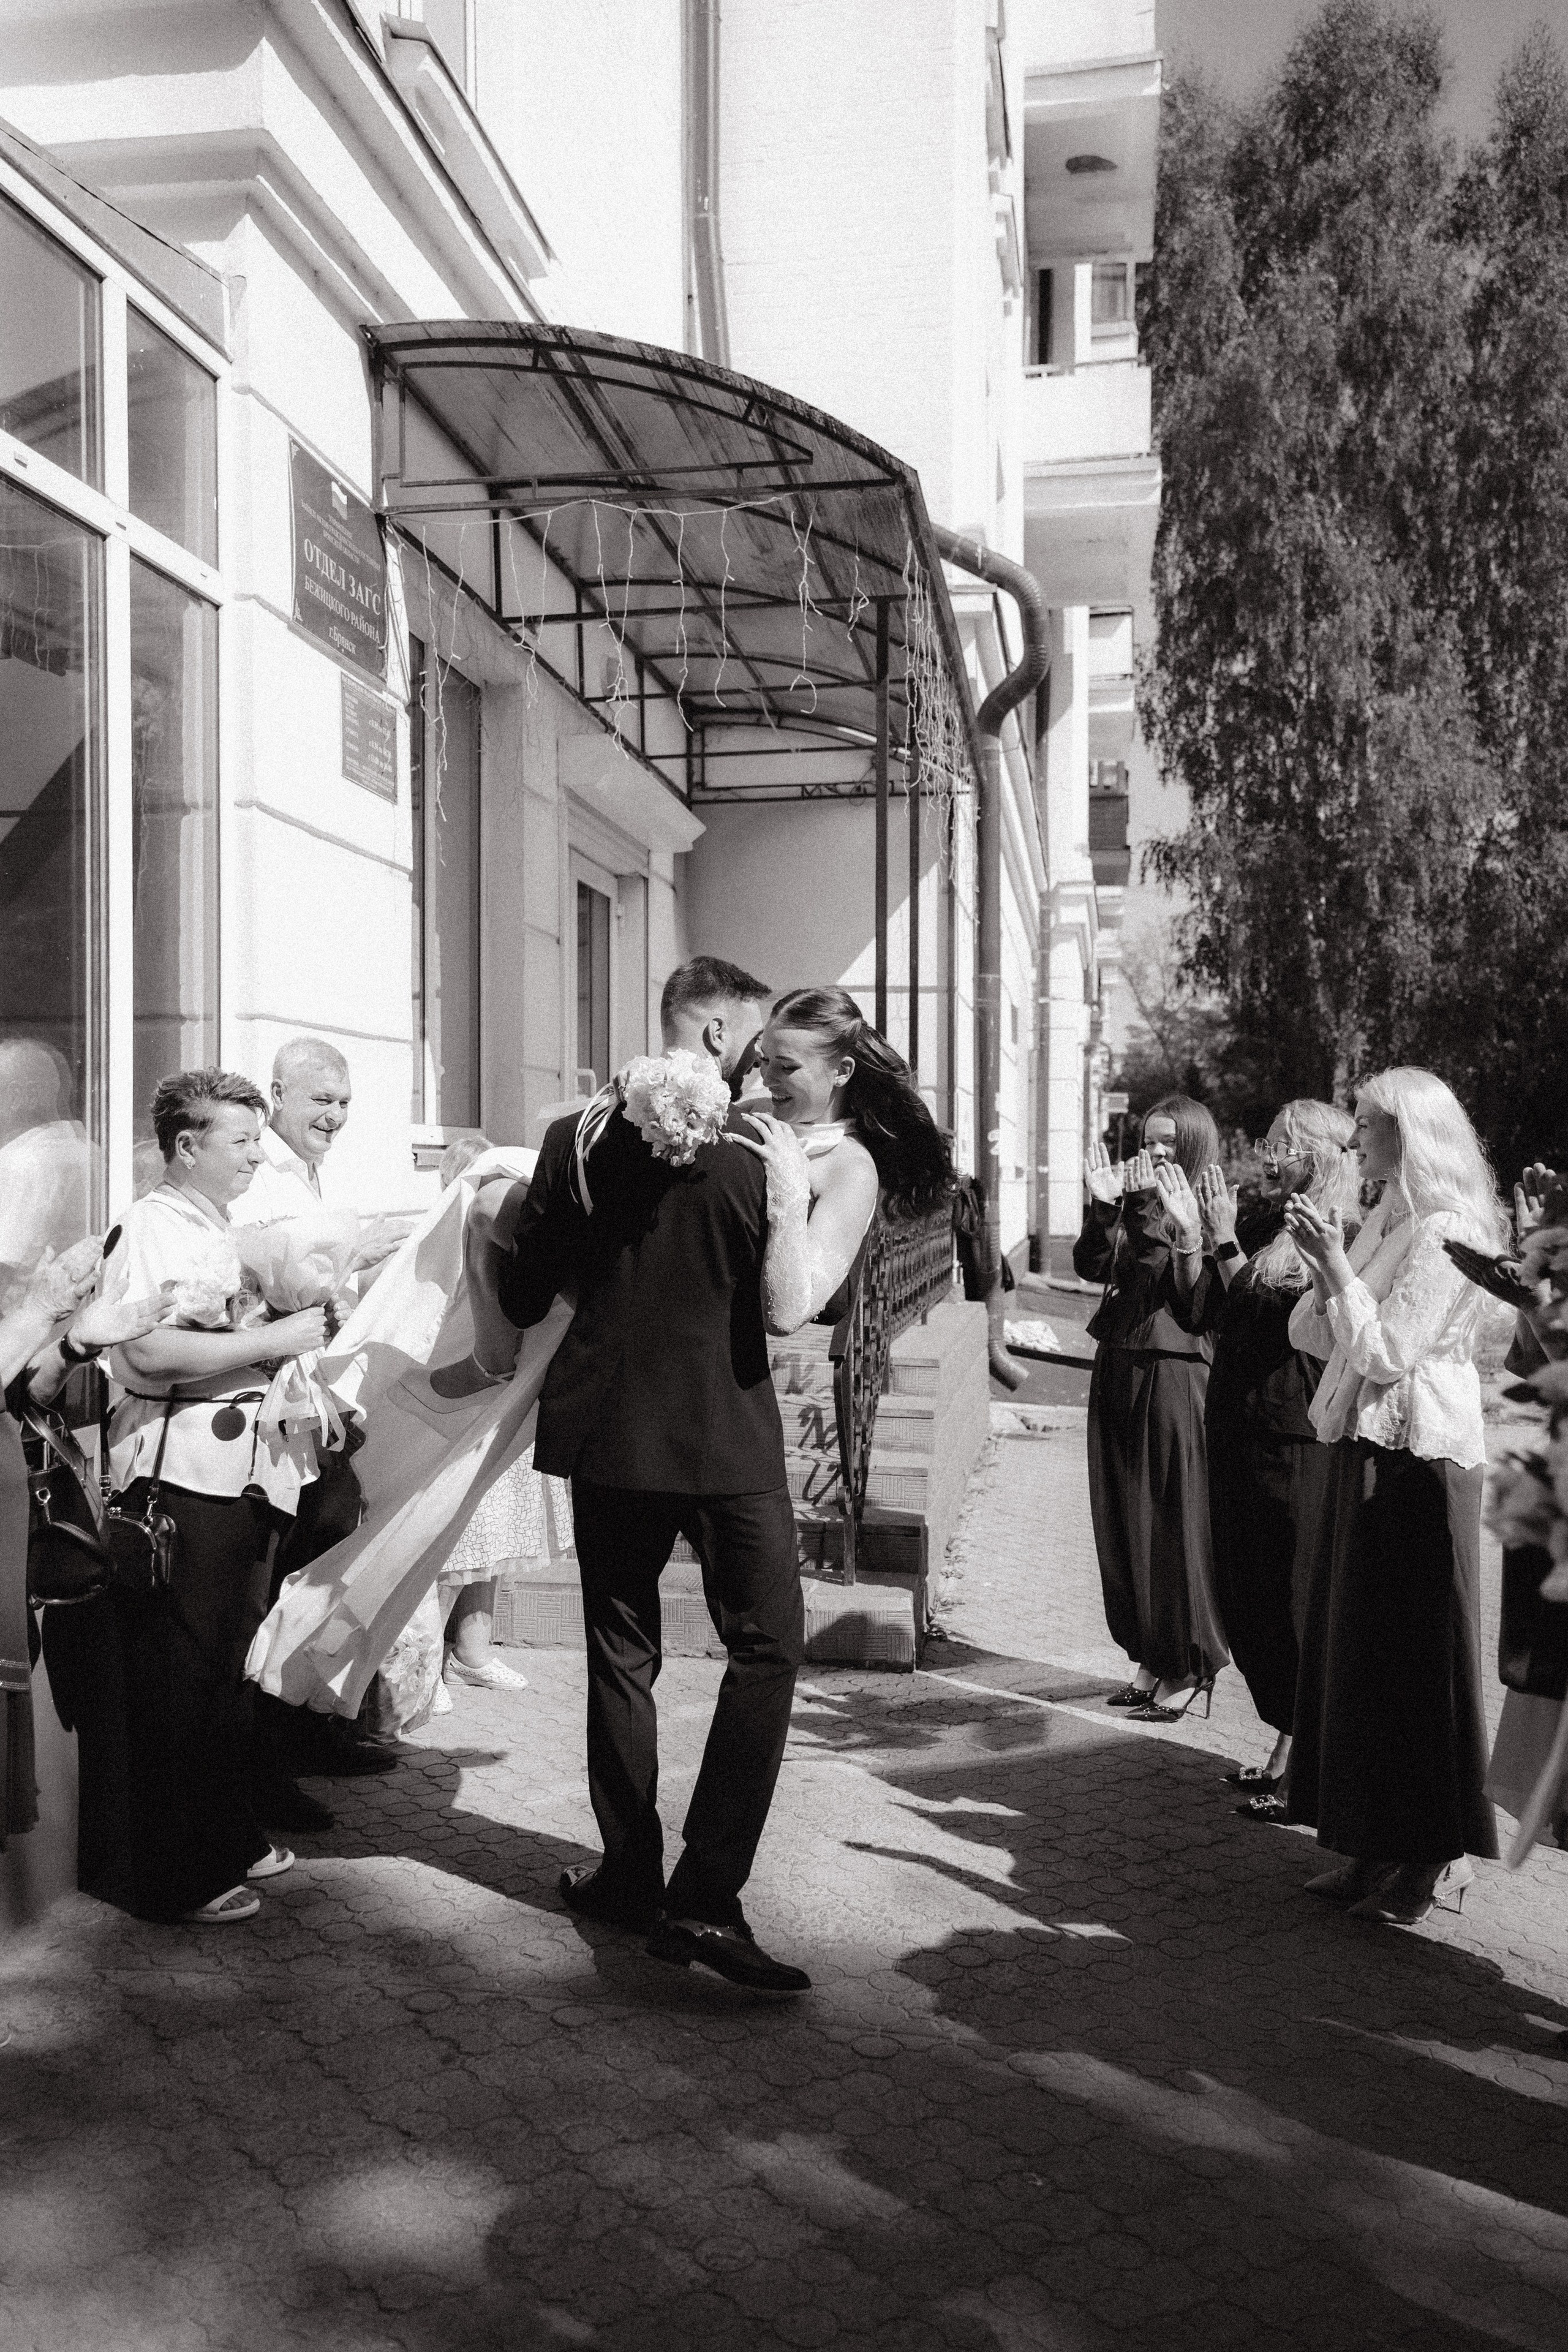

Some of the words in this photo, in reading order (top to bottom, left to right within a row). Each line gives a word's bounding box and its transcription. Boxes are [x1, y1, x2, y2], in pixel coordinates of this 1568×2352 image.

[304, 538, 345, 591] ОТДЕЛ
[349, 574, 380, 616] ЗАГС
[305, 575, 350, 621] БЕЖИЦКОГО
[351, 611, 380, 644] РАЙОНА
